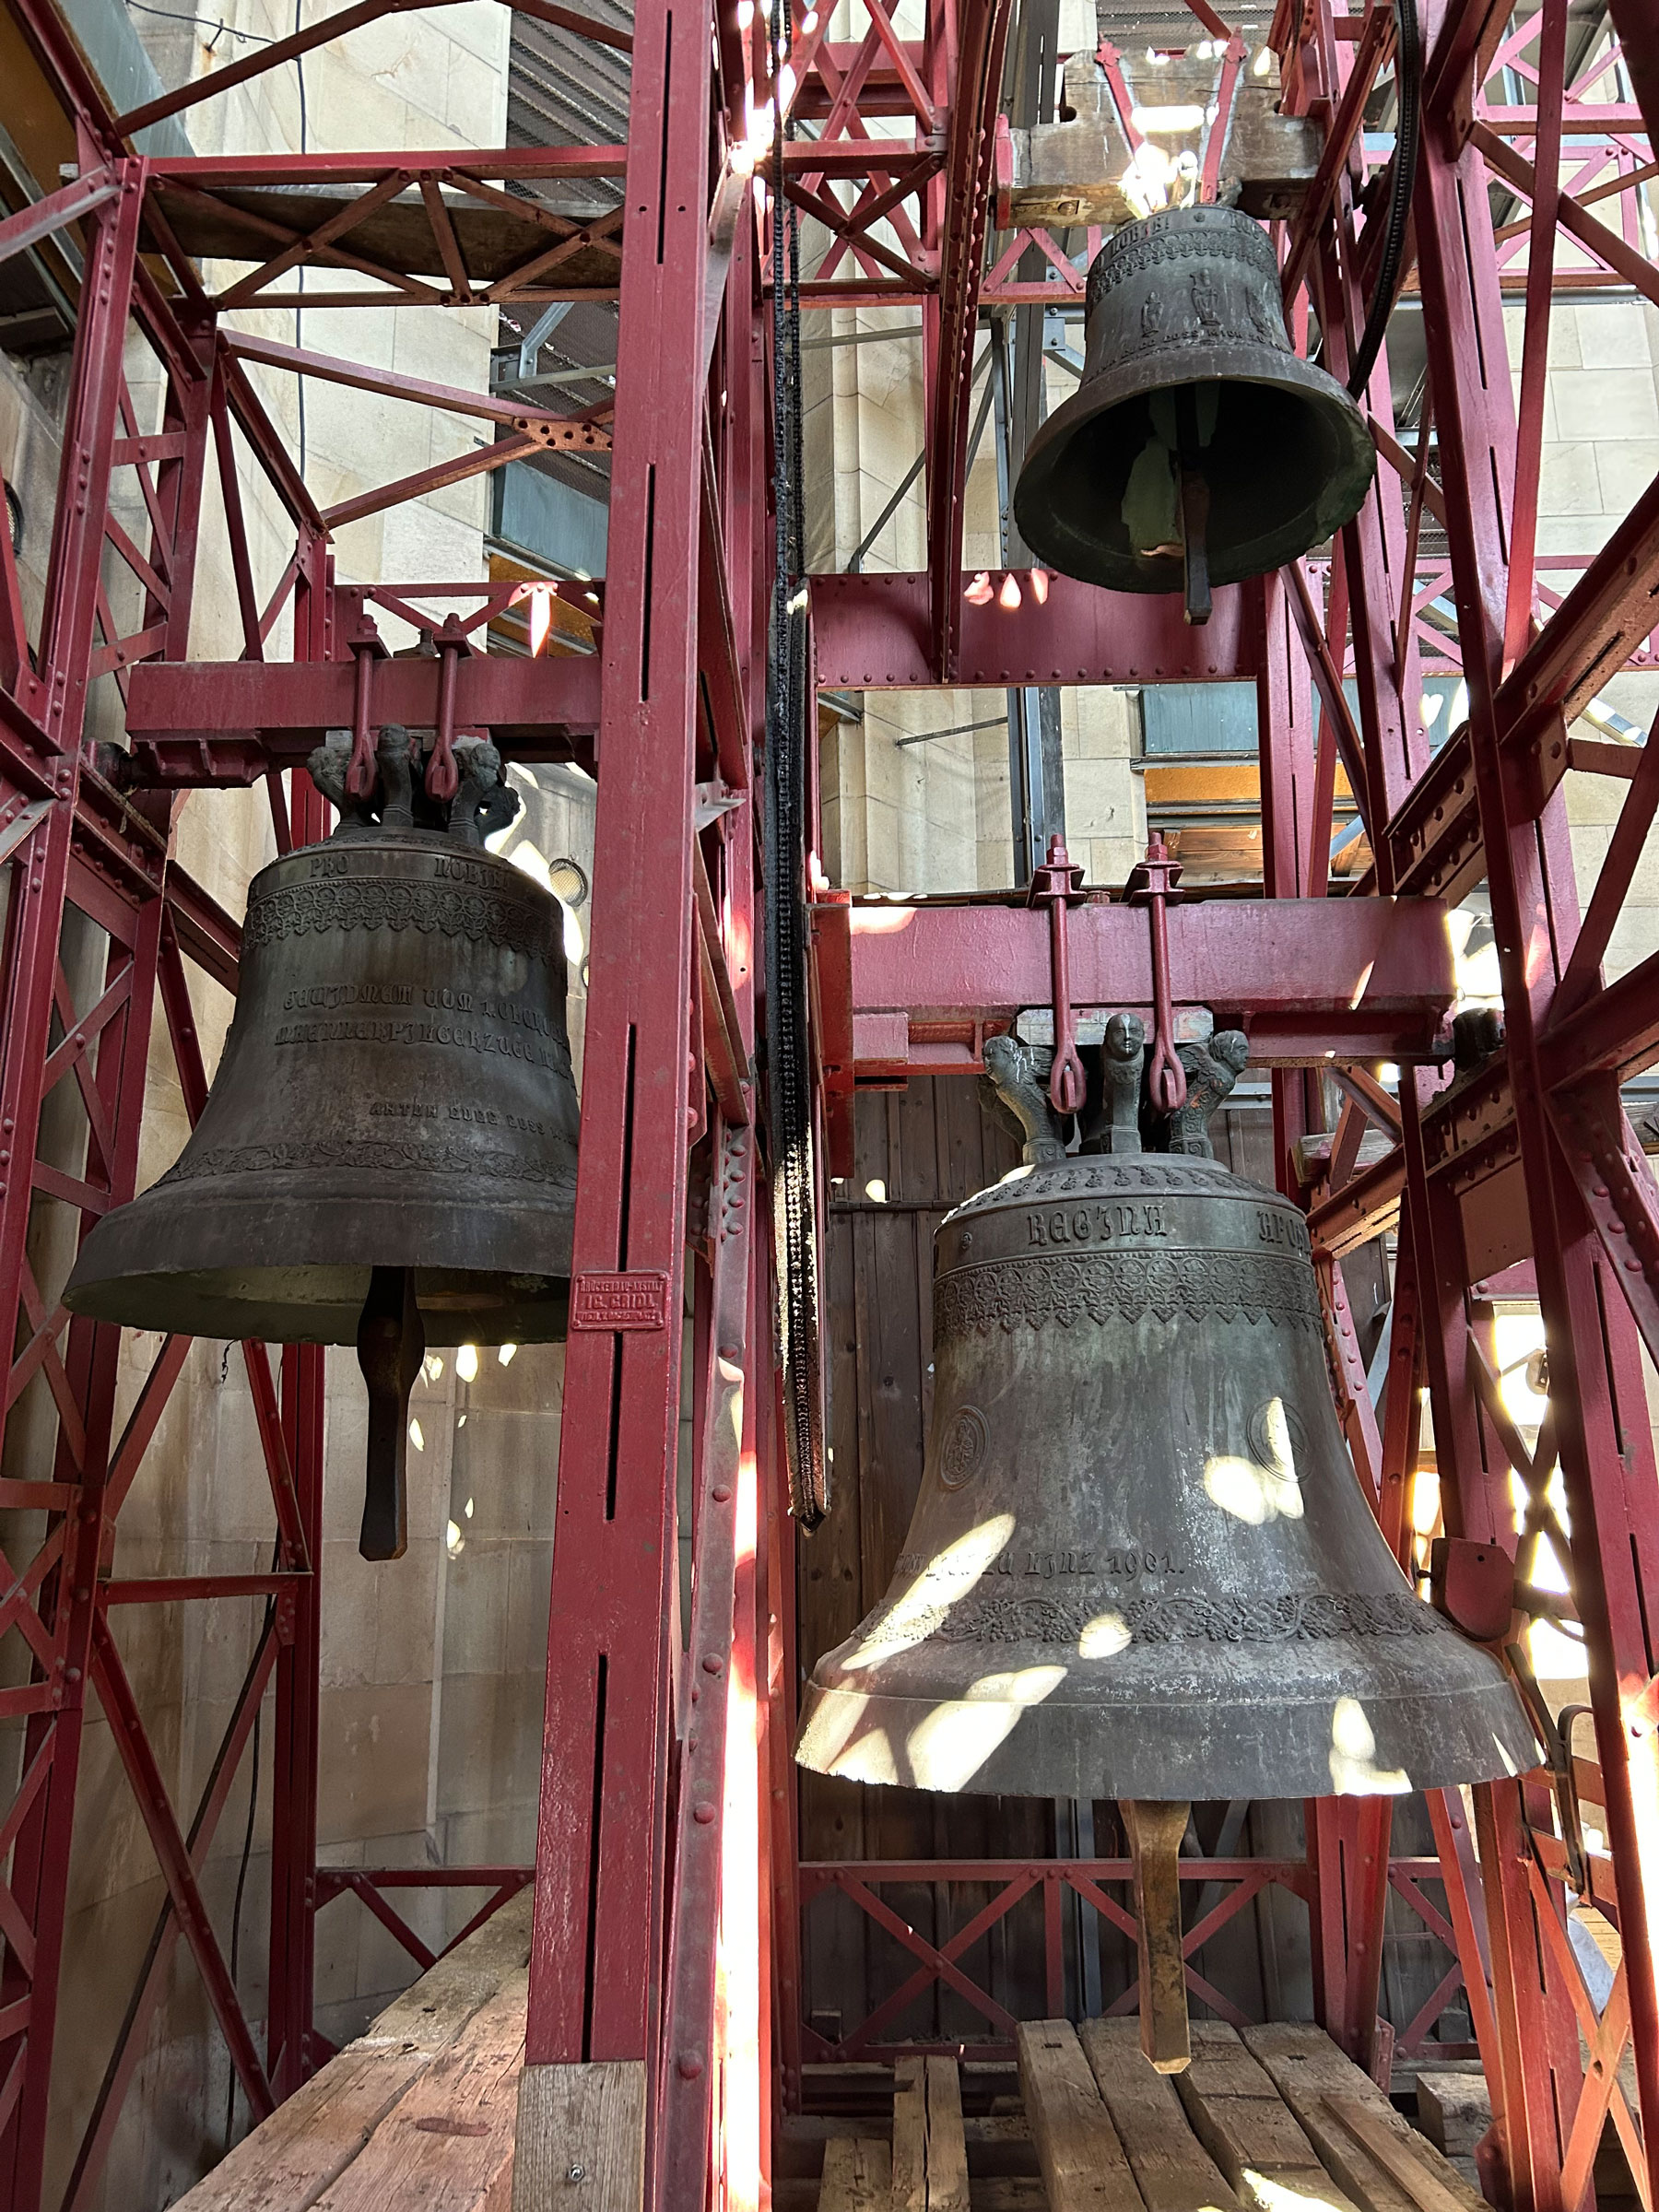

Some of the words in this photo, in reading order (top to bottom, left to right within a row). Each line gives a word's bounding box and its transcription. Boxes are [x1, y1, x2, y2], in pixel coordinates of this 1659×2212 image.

[309, 855, 349, 877] PRO
[423, 988, 474, 1013] VOM
[369, 1101, 439, 1119] ANTON
[1026, 1203, 1168, 1247] REGINA
[1024, 1550, 1098, 1579] LINZ
[1106, 1550, 1185, 1583] 1901.
